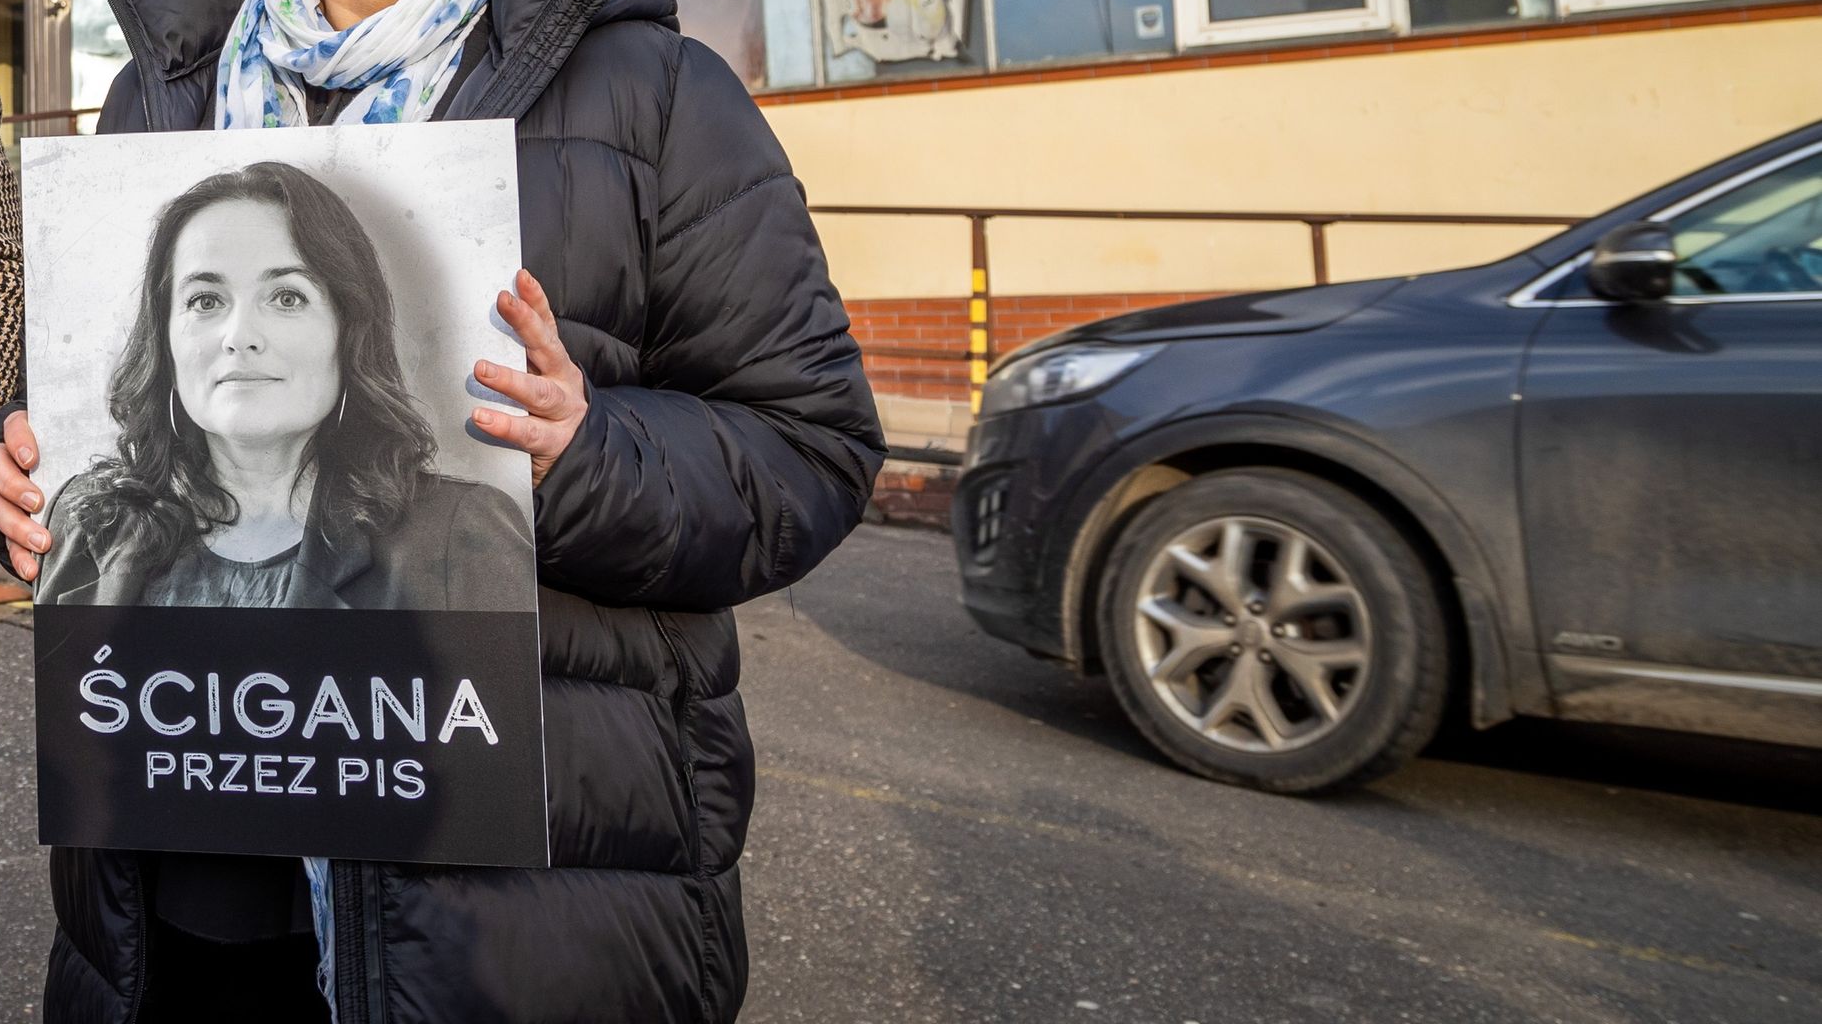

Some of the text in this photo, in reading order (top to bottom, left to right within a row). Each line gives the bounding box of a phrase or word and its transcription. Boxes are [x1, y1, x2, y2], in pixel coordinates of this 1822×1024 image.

[79, 644, 499, 745] ŚCIGANA
[146, 751, 426, 799] PRZEZ PIS
